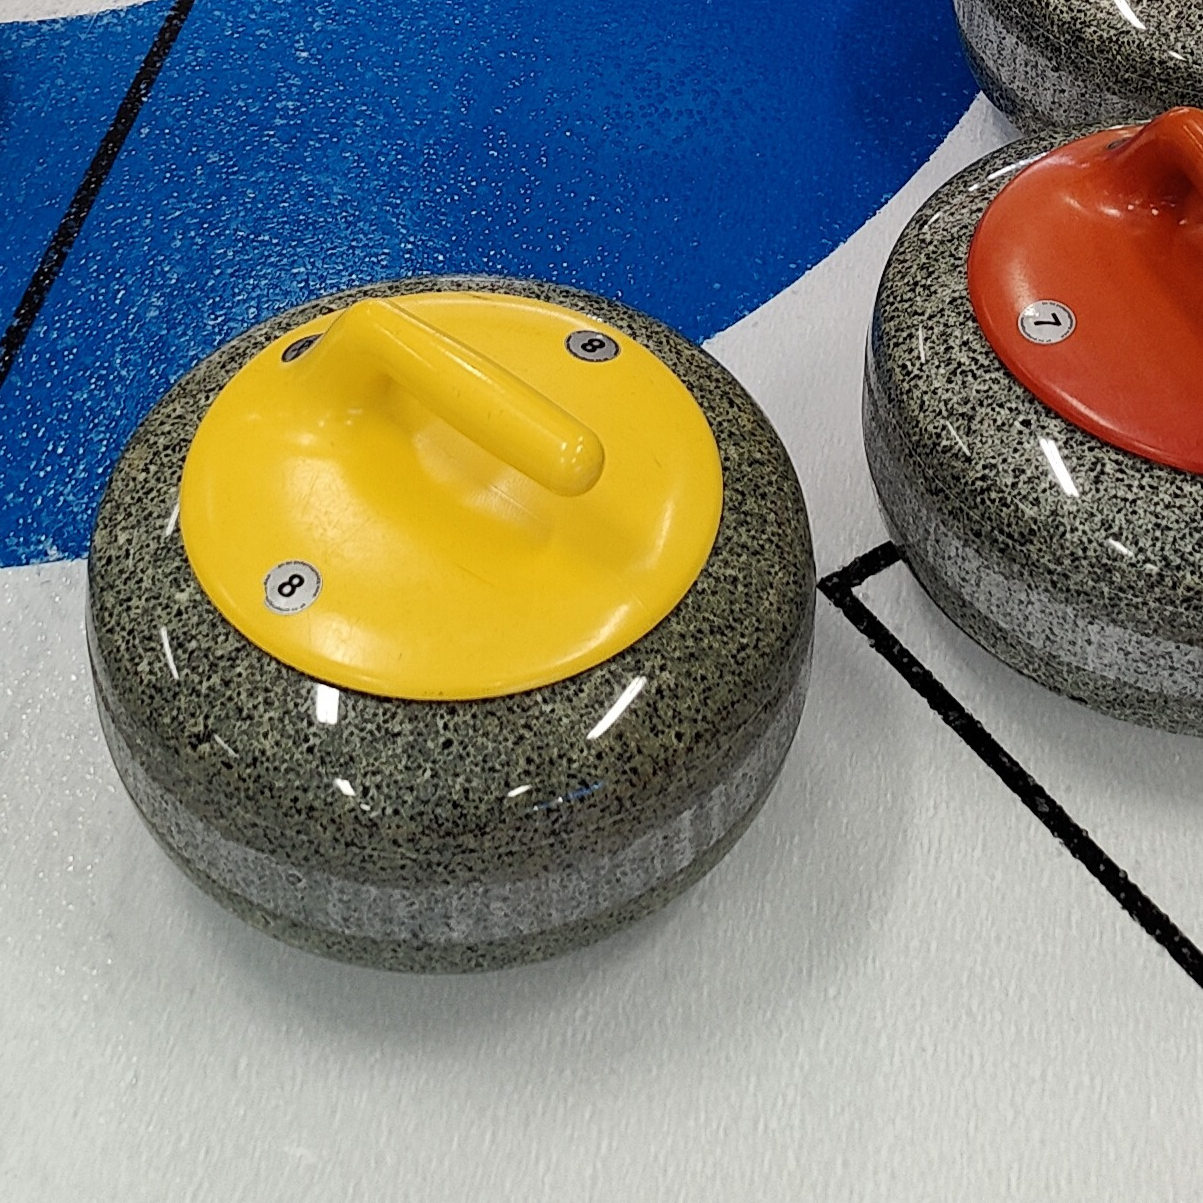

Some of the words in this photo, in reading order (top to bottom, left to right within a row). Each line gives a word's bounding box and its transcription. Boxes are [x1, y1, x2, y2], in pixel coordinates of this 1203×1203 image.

[1033, 312, 1062, 327] 7
[580, 339, 606, 353] 8
[277, 573, 305, 598] 8
